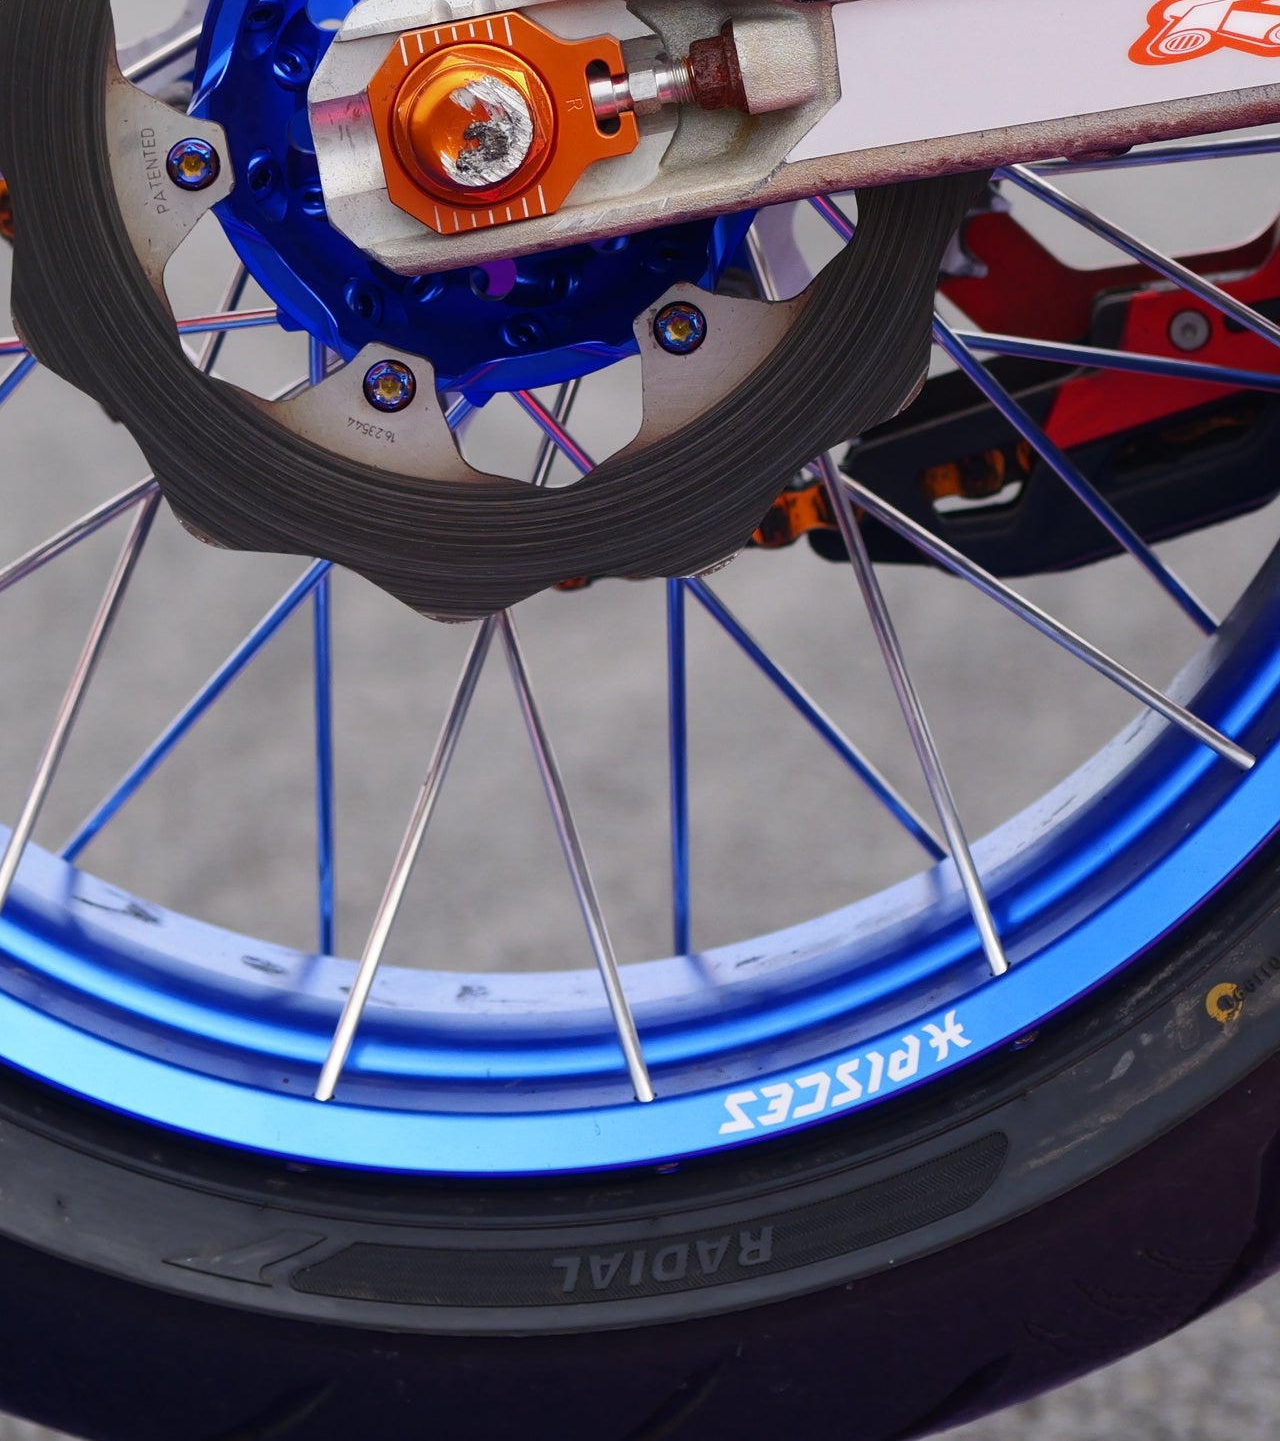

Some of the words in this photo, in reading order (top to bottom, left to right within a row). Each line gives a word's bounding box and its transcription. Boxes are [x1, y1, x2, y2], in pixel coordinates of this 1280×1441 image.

[141, 128, 170, 215] PATENTED
[718, 1034, 920, 1135] PISCES
[551, 1226, 774, 1292] RADIAL
